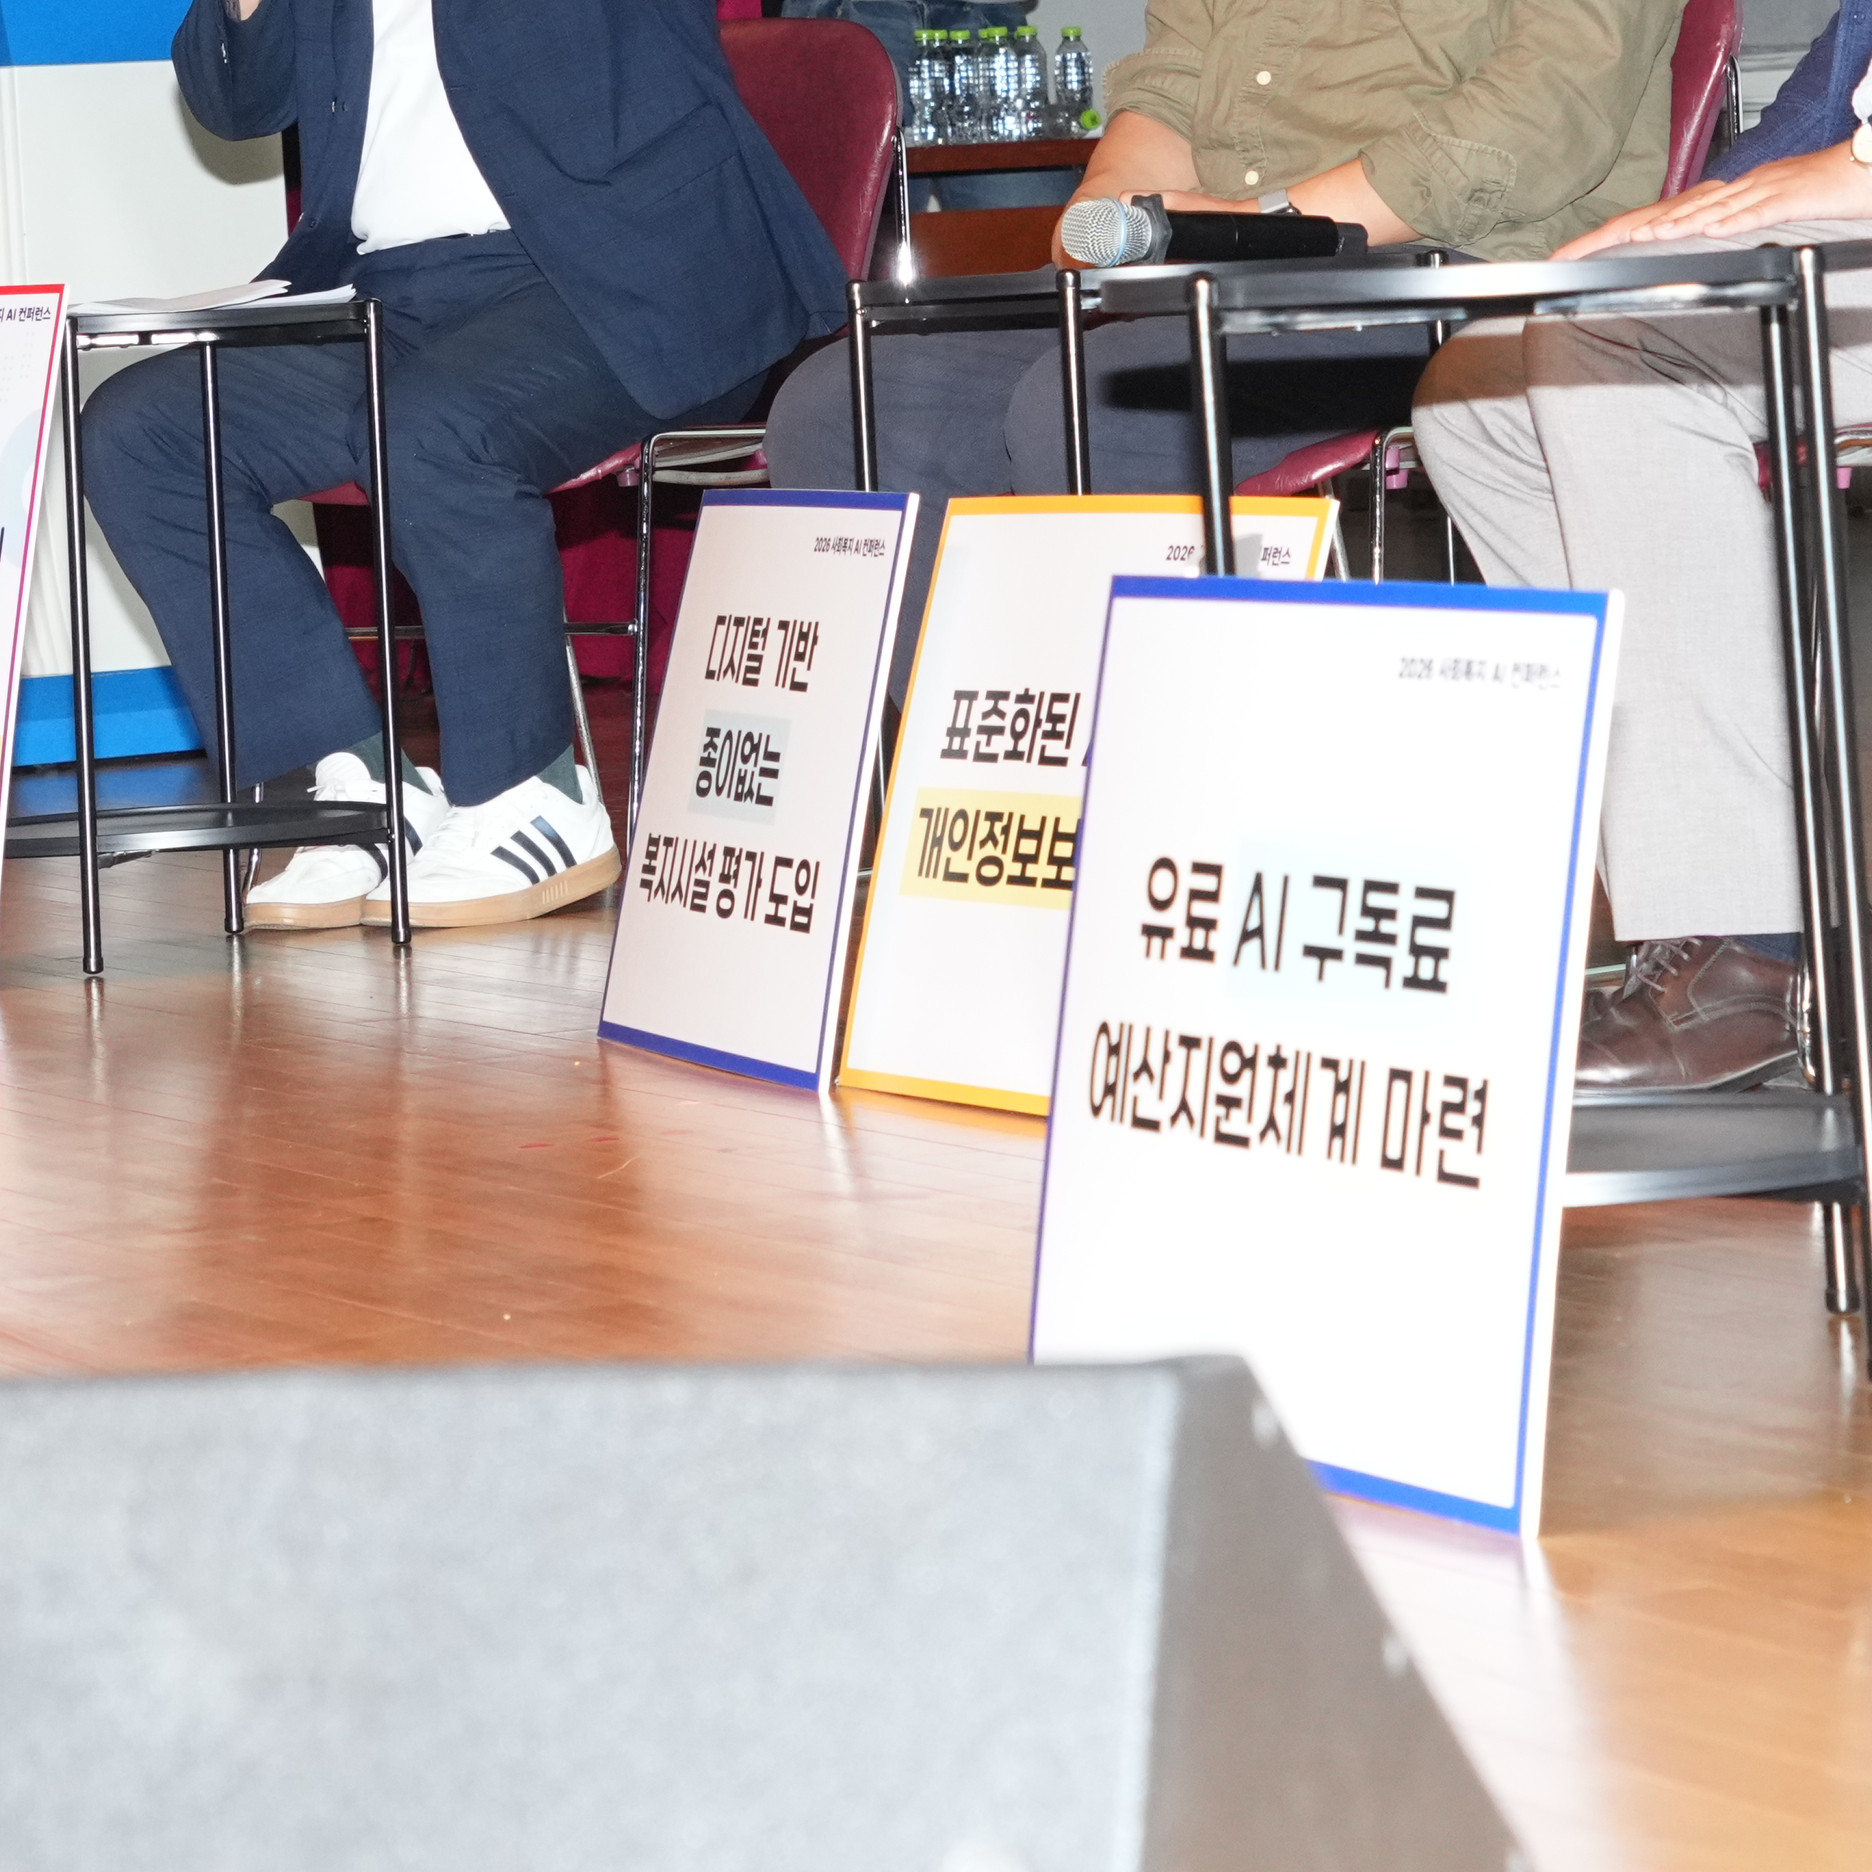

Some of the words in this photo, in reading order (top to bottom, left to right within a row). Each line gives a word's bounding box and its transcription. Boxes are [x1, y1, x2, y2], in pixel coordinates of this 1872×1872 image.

[5, 308, 17, 321] AI
[18, 307, 51, 322] 컨퍼런스
[814, 537, 831, 552] 2026
[831, 536, 855, 556] 사회복지
[854, 539, 863, 555] AI
[862, 538, 886, 557] 컨퍼런스
[1260, 546, 1291, 566] 퍼런스
[704, 614, 770, 688] 디지털
[774, 619, 820, 693] 기반
[695, 726, 782, 807] 종이없는
[940, 687, 1081, 768] 표준화된
[639, 832, 717, 914] 복지시설
[713, 843, 766, 924] 평가
[764, 854, 820, 934] 도입
[1140, 856, 1223, 963] 유료
[1232, 871, 1289, 972] AI
[1302, 874, 1456, 994] 구독료
[1089, 1020, 1367, 1166] 예산지원체계
[1380, 1067, 1489, 1189] 마련
